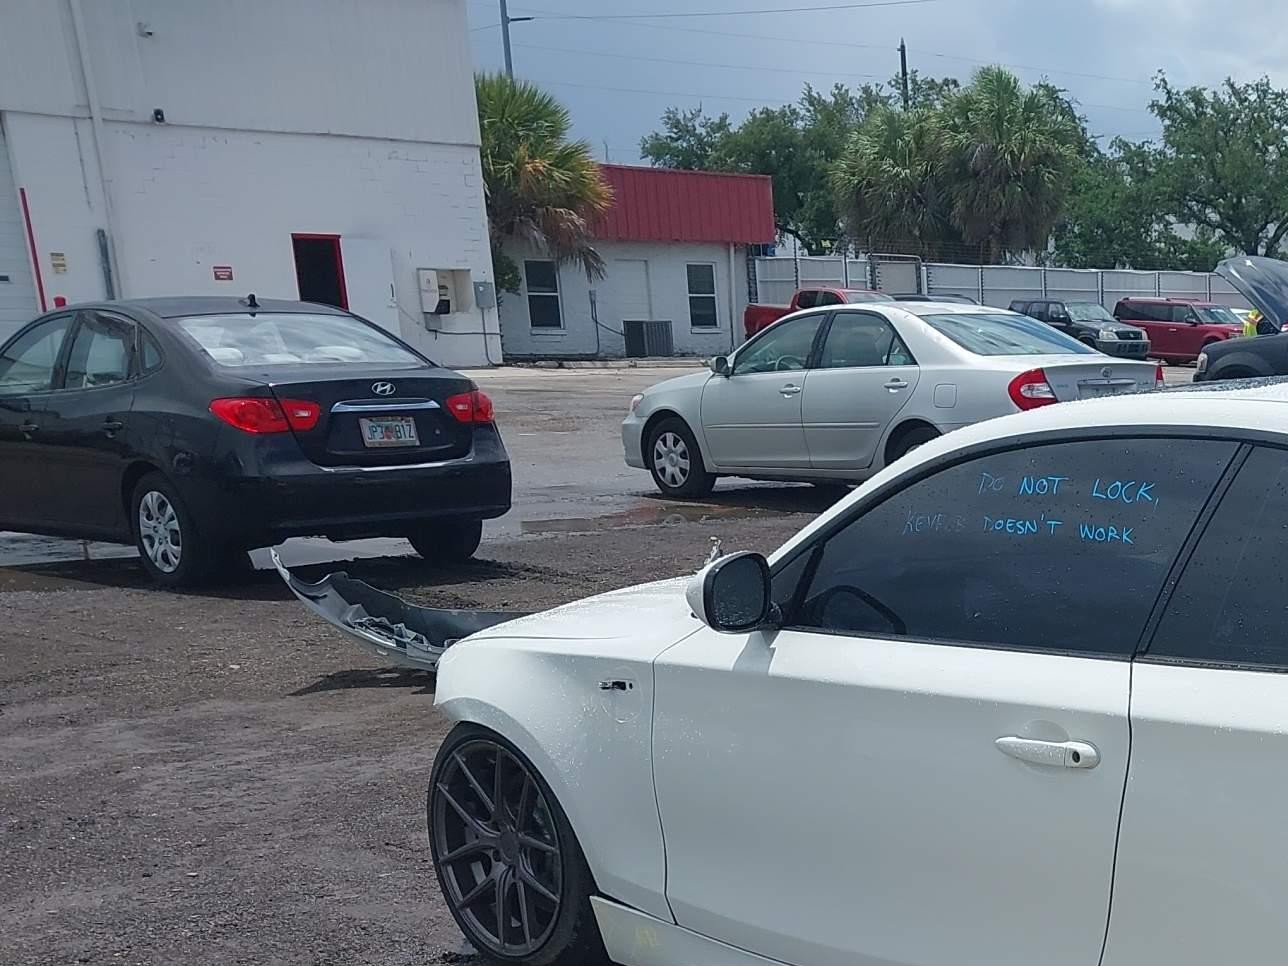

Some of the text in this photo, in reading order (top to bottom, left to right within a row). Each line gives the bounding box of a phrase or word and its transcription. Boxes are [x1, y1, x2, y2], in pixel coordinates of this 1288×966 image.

[978, 472, 1160, 511] DO NOT LOCK,
[983, 513, 1063, 535] DOESN'T
[1079, 523, 1134, 545] WORK
